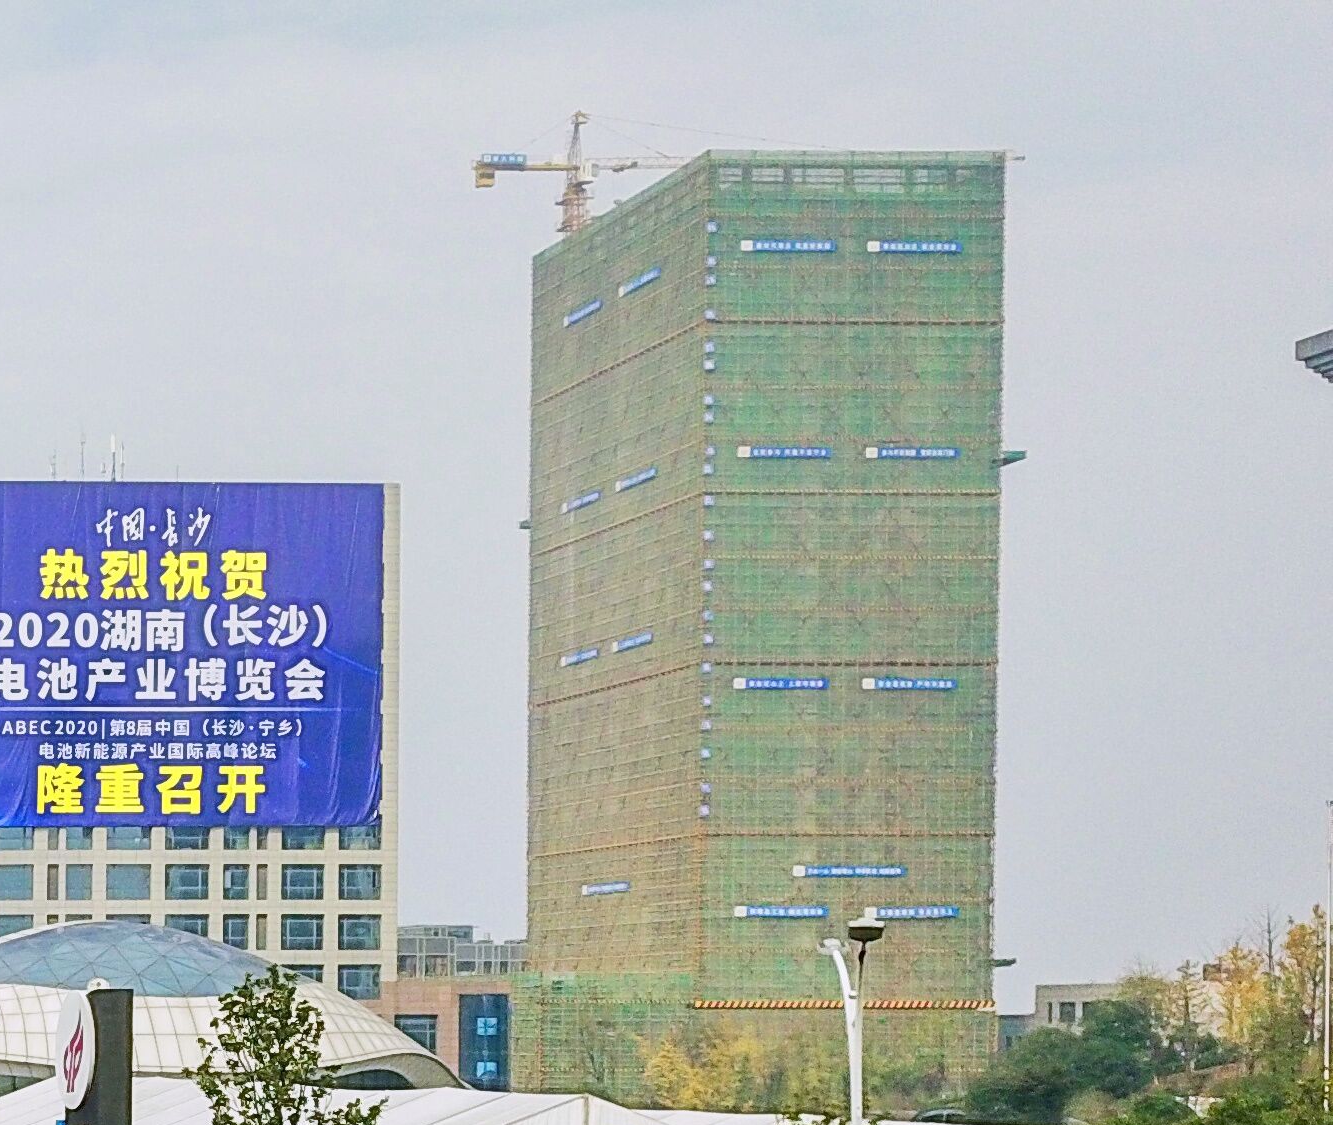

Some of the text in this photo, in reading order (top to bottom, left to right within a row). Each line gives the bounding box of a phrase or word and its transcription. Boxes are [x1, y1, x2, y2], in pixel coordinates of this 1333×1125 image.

[39, 549, 268, 601] 热烈祝贺
[38, 742, 277, 761] 电池新能源产业国际高峰论坛
[36, 764, 267, 816] 隆重召开
